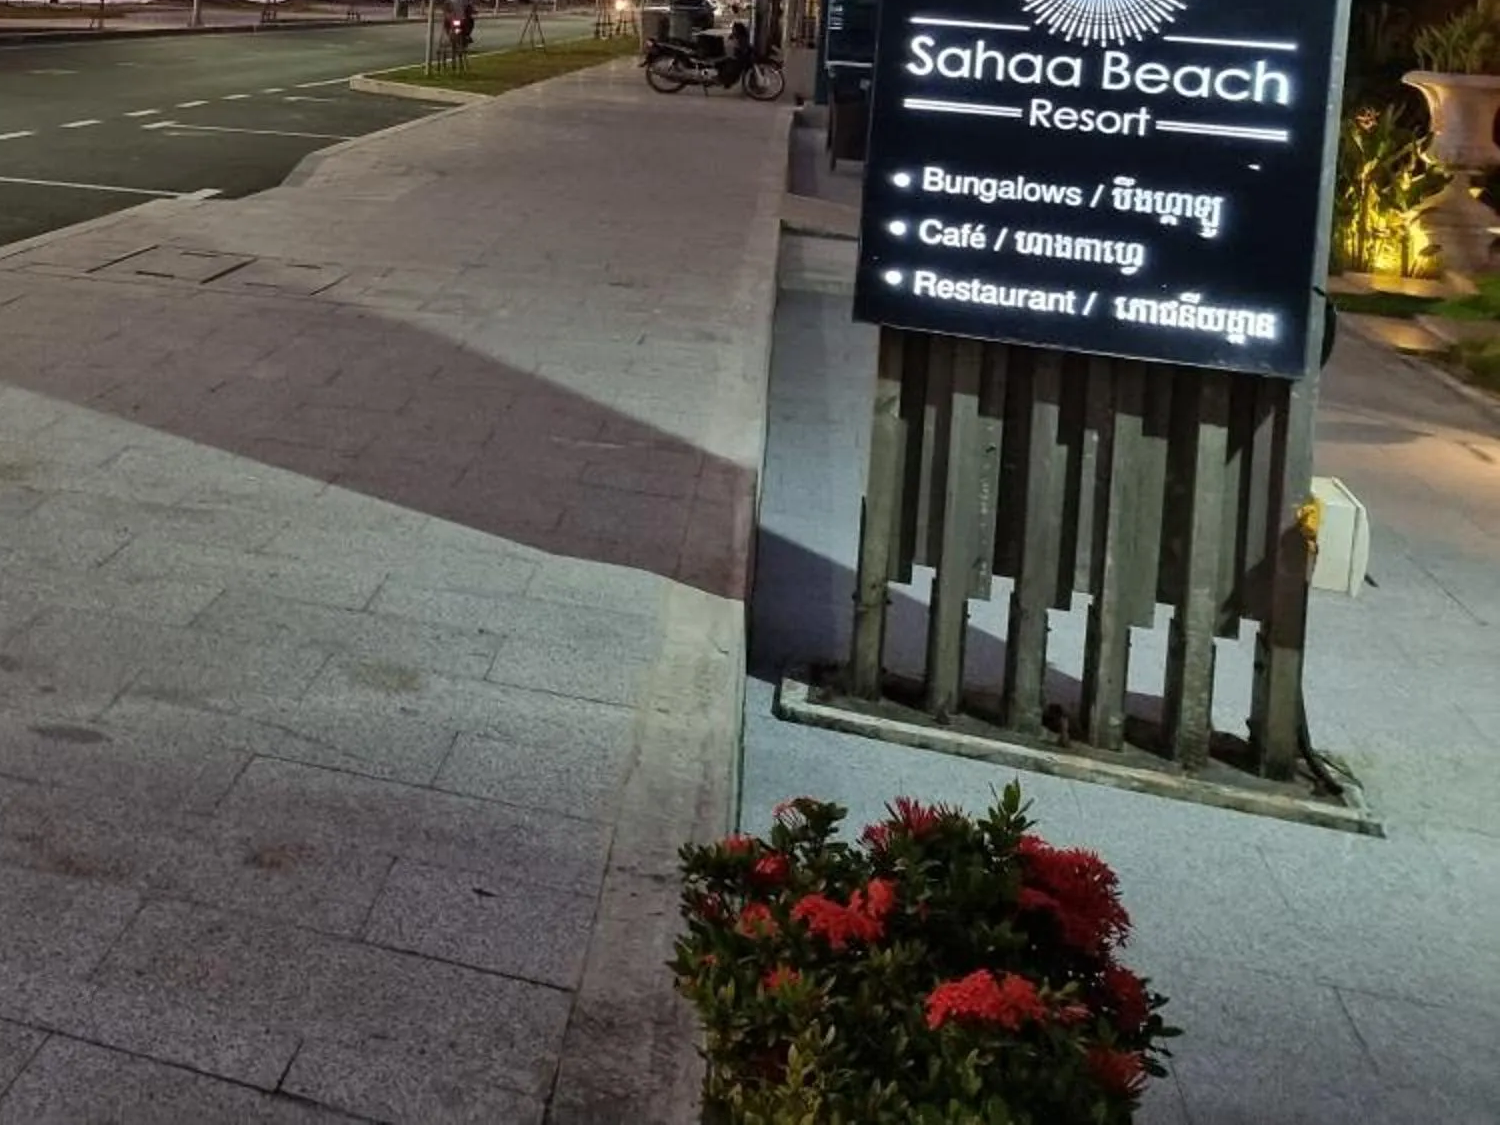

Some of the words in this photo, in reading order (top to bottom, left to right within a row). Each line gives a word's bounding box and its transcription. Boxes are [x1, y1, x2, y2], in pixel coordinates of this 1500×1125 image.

[906, 35, 1082, 86] Sahaa
[1102, 51, 1290, 104] Beach
[1029, 99, 1150, 136] Resort
[923, 167, 1082, 205] Bungalows
[919, 219, 986, 249] Café
[914, 271, 1076, 314] Restaurant
